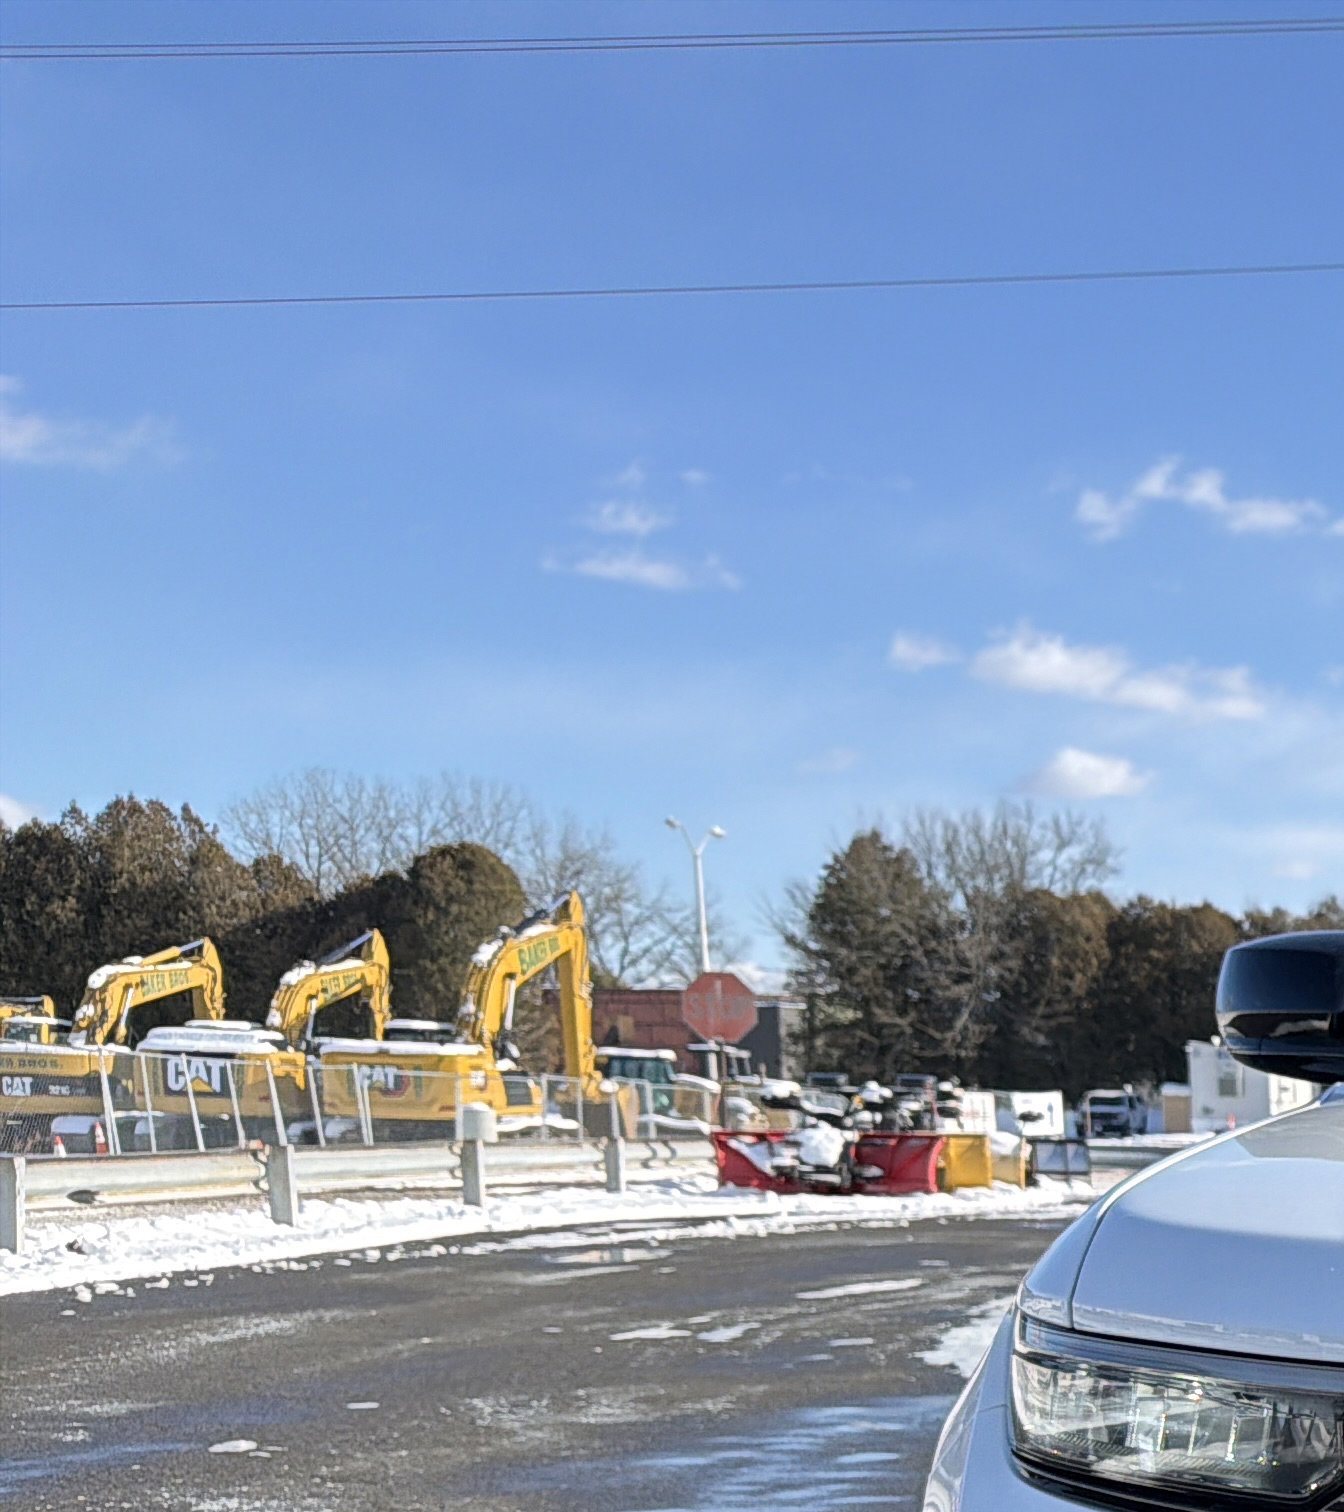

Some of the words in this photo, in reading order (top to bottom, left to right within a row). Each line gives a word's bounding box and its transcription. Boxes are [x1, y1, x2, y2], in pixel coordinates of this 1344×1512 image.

[687, 992, 750, 1019] STOP
[2, 1076, 33, 1097] CAT
[166, 1057, 228, 1092] CAT
[358, 1065, 398, 1091] CAT
